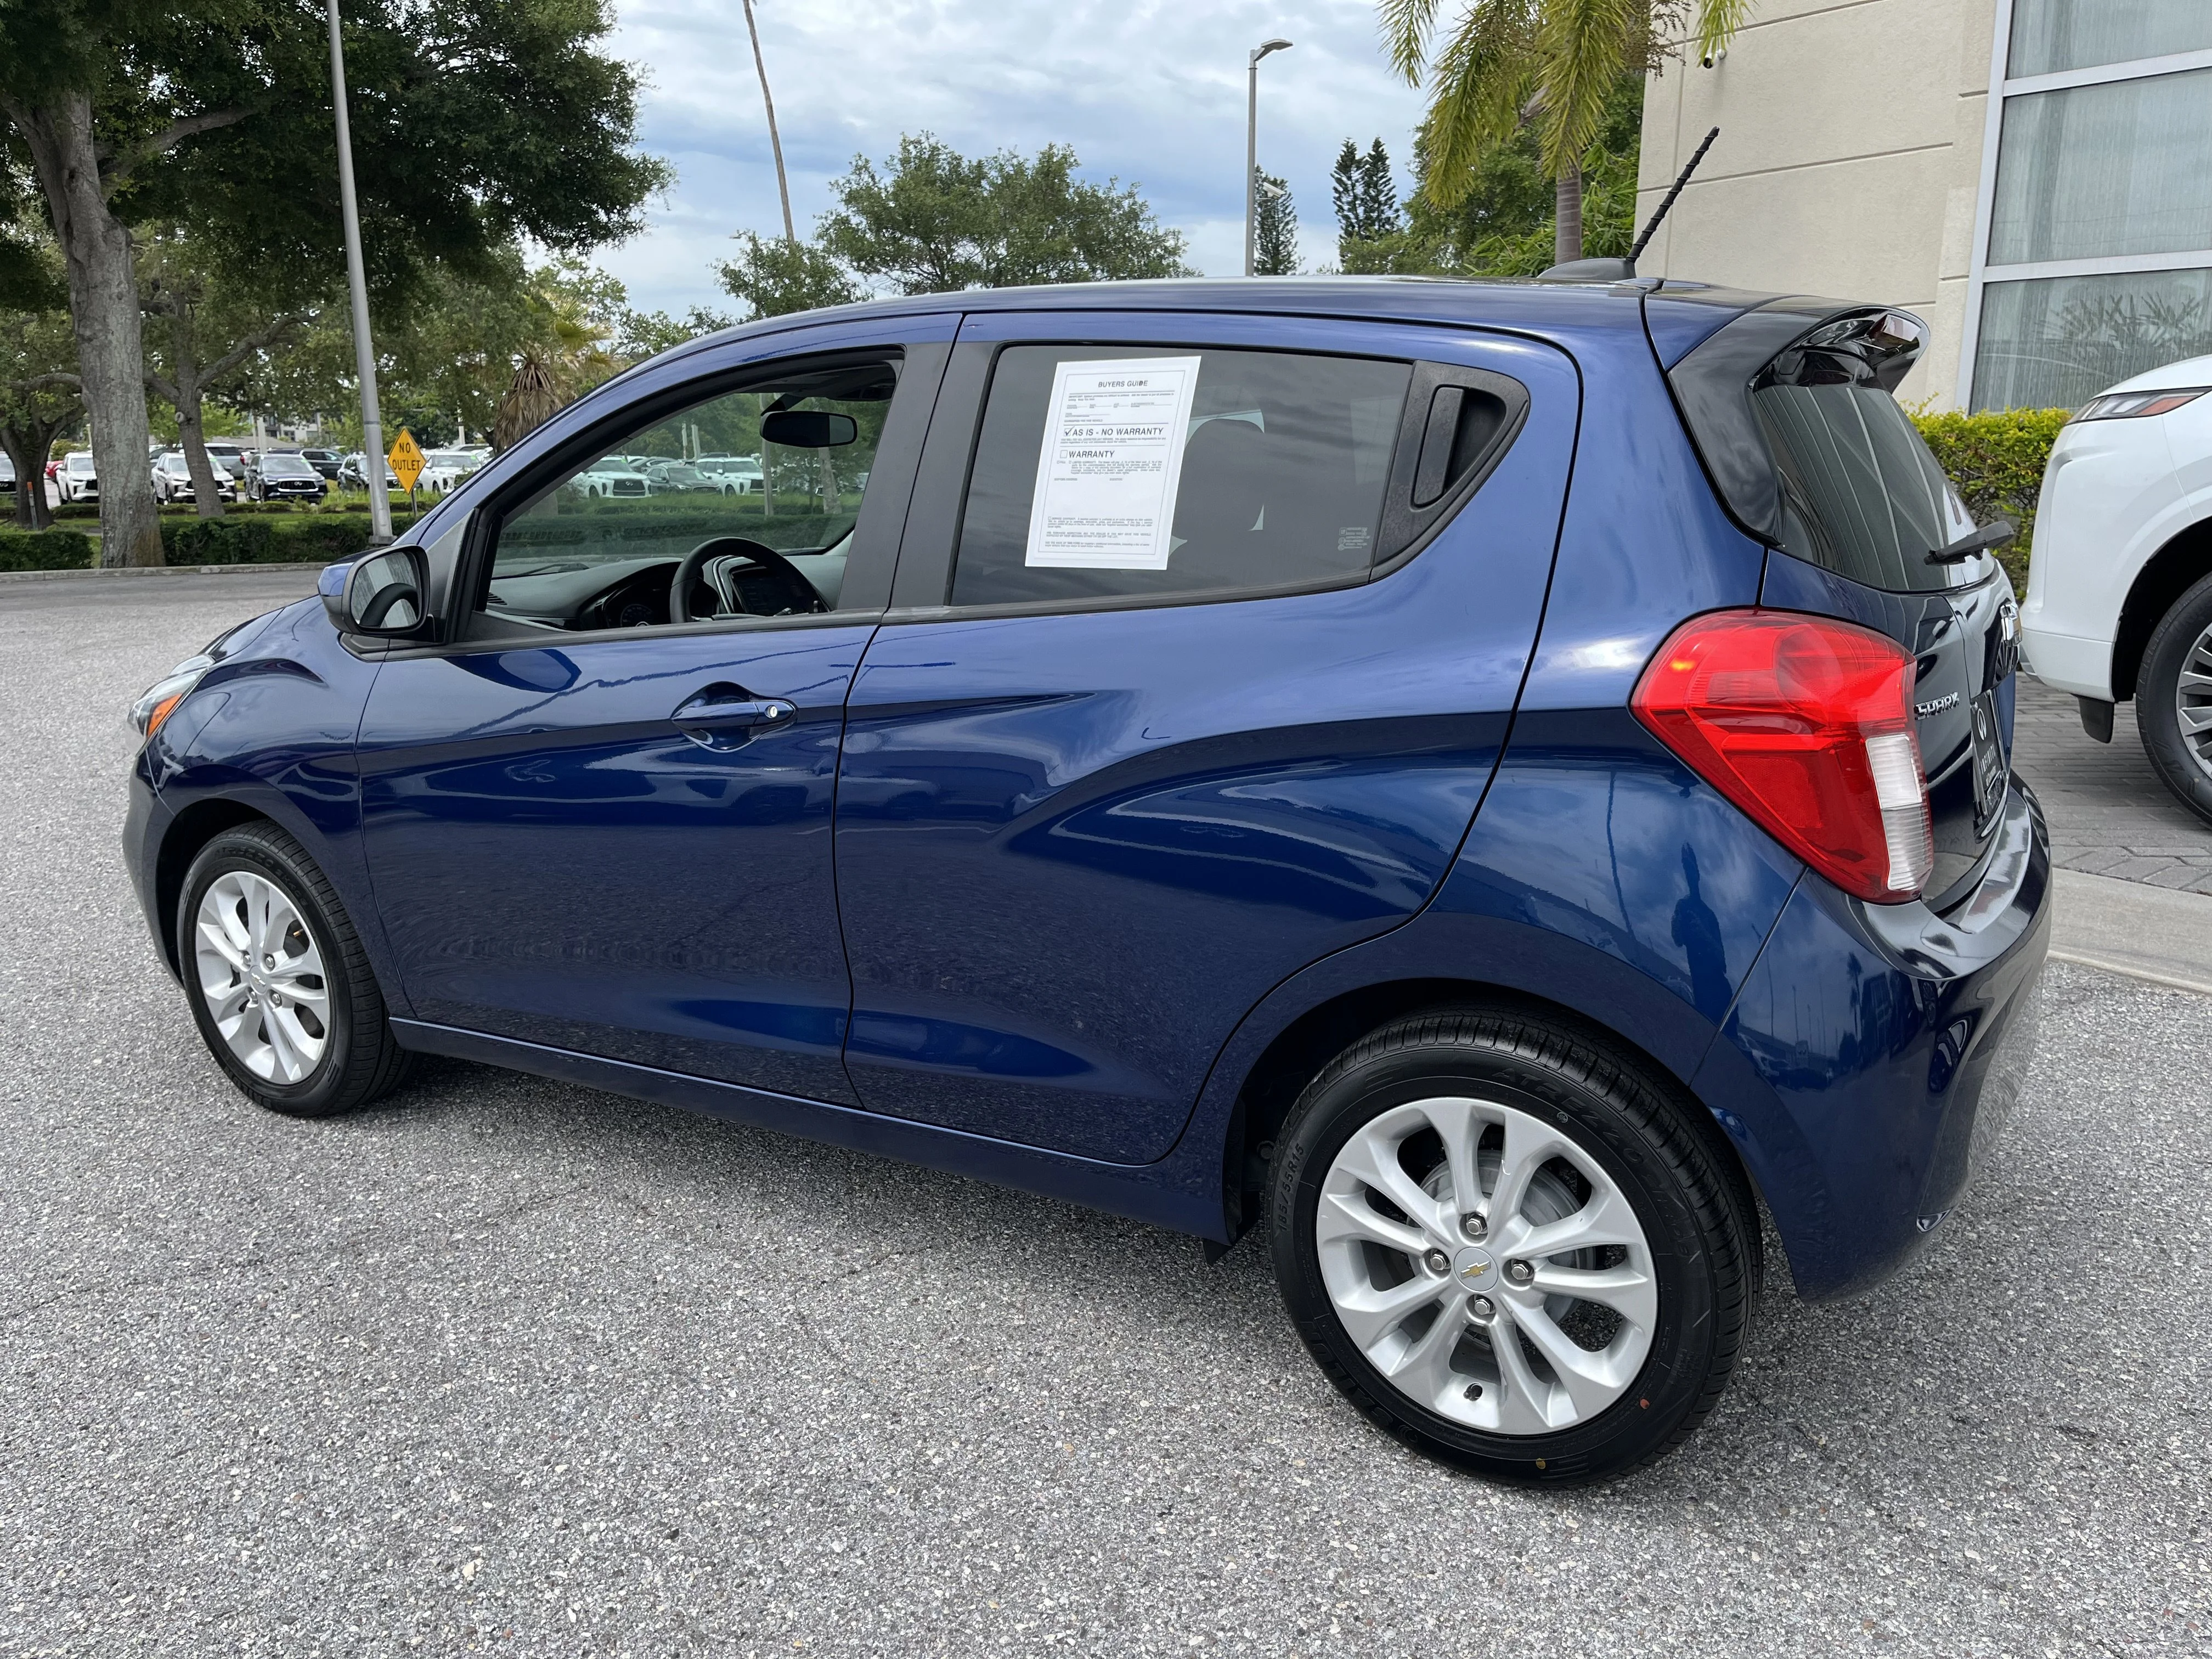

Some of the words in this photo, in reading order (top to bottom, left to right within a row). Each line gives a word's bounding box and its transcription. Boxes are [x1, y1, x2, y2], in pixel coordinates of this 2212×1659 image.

[1116, 427, 1164, 435] WARRANTY
[399, 442, 411, 453] NO
[1068, 449, 1115, 458] WARRANTY
[392, 459, 421, 471] OUTLET
[1914, 691, 1960, 720] SPARK
[1492, 1068, 1644, 1163] ATREZZO
[1278, 1143, 1304, 1231] 185/55R15
